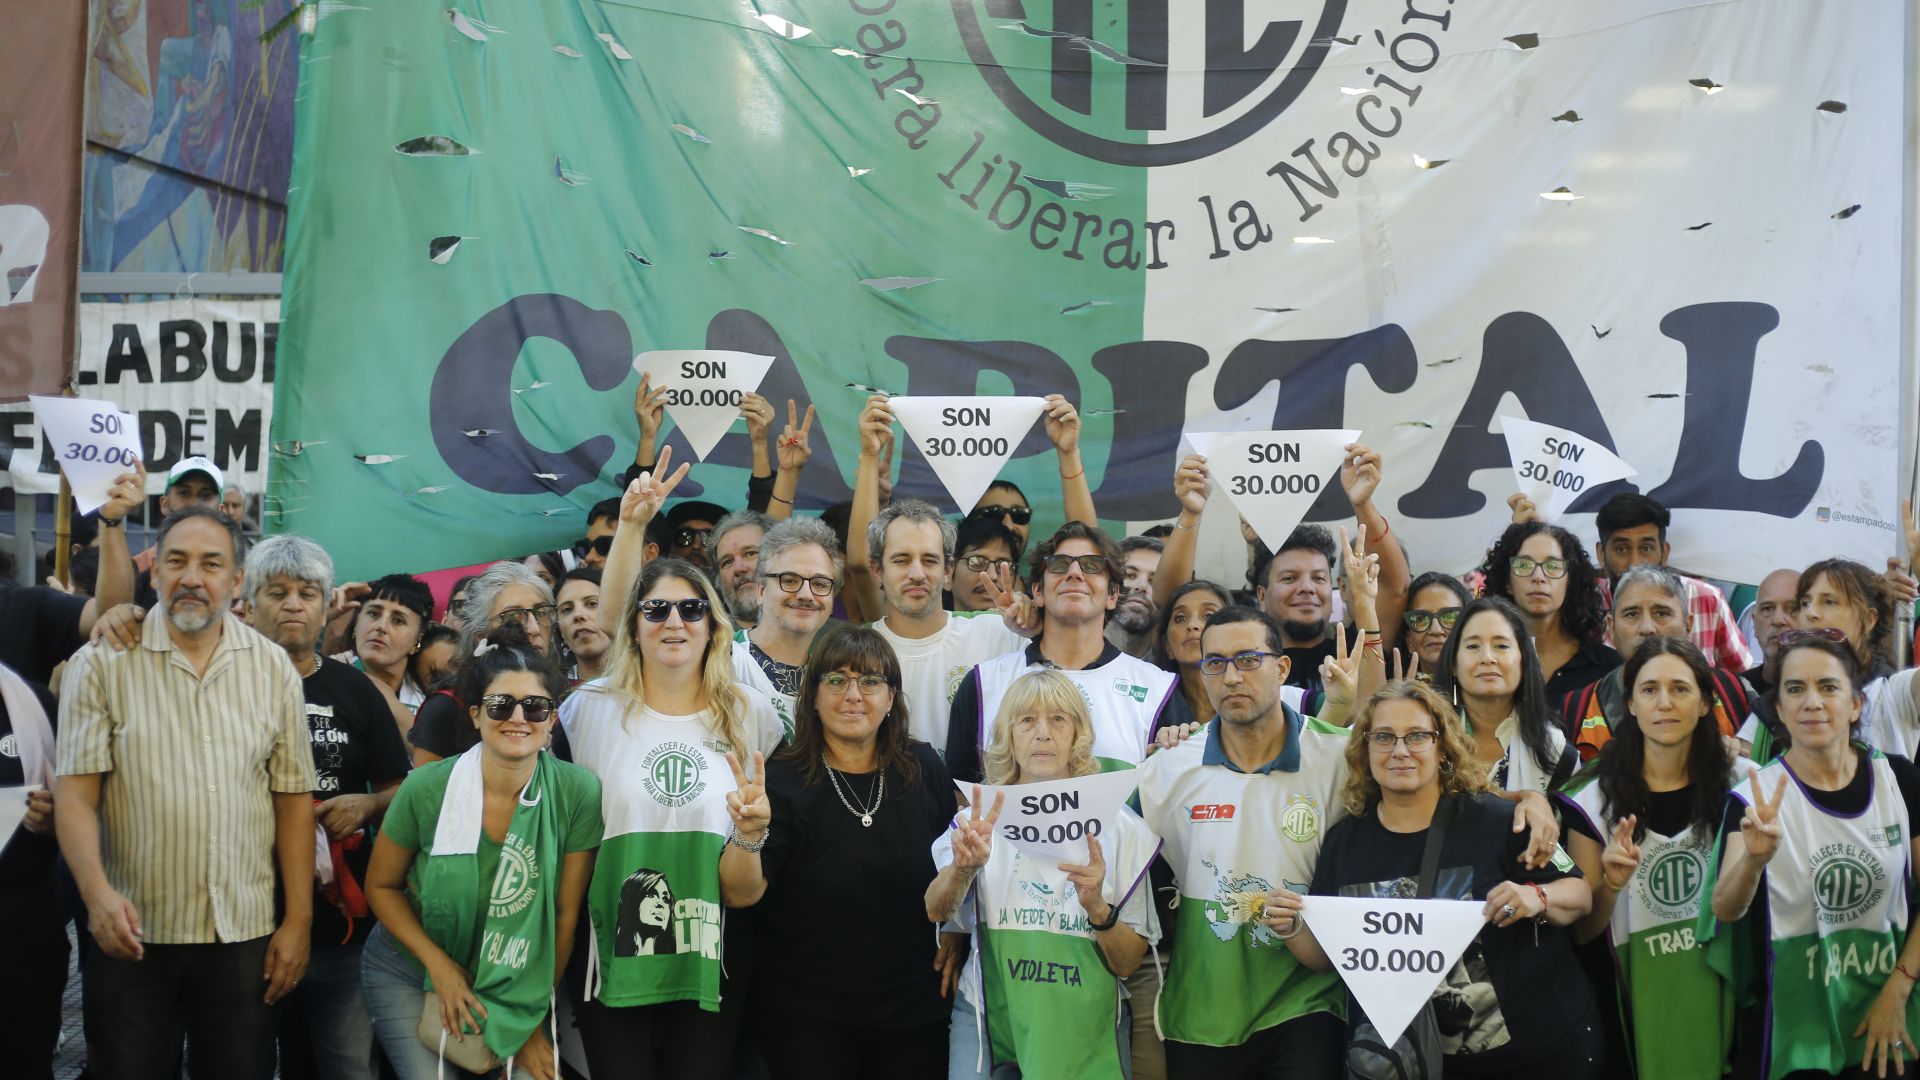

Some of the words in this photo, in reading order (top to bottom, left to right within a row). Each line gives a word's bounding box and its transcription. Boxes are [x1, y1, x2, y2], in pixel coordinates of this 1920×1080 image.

[937, 131, 1176, 271] liberar
[1198, 194, 1273, 260] la
[680, 361, 727, 379] SON
[664, 388, 743, 407] 30.000
[942, 407, 992, 427] SON
[925, 437, 1008, 457] 30.000
[1248, 443, 1300, 463] SON
[1542, 437, 1585, 463] SON
[1230, 474, 1320, 496] 30.000
[1519, 460, 1585, 492] 30.000
[641, 741, 678, 770] FORTALECER
[679, 742, 689, 753] EL
[687, 746, 709, 770] ESTADO
[655, 754, 693, 794] ATE
[1020, 790, 1080, 816] SON
[1003, 818, 1102, 844] 30.000
[1288, 811, 1315, 835] ATE
[1845, 844, 1857, 858] EL
[1858, 849, 1885, 881] ESTADO
[1653, 856, 1696, 902] ATE
[1819, 863, 1865, 907] ATE
[496, 906, 509, 918] LA
[508, 887, 537, 915] NACION
[1847, 911, 1859, 922] LA
[1859, 888, 1884, 916] NACION
[1014, 907, 1045, 926] VERDE
[1047, 911, 1056, 927] Y
[1362, 911, 1424, 936] SON
[487, 931, 531, 969] BLANCA
[1341, 947, 1446, 974] 30.000
[1007, 958, 1082, 987] VIOLETA
